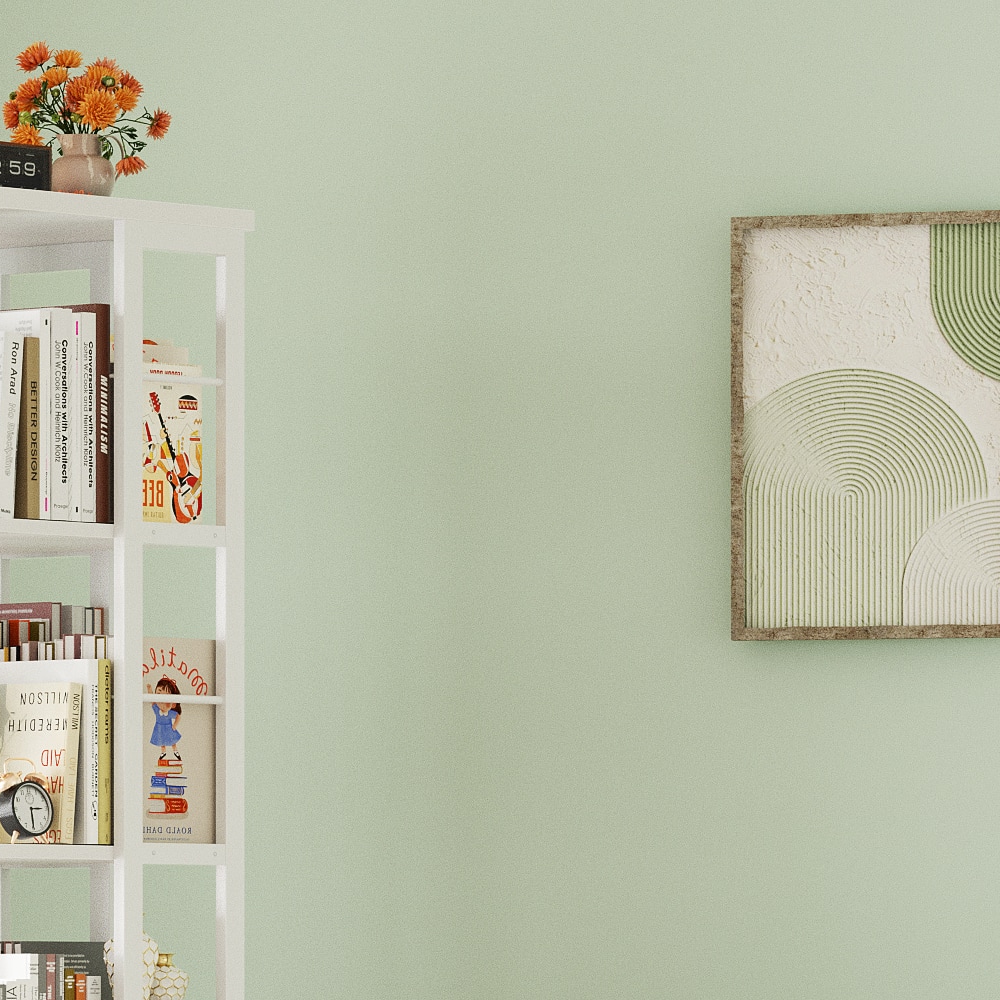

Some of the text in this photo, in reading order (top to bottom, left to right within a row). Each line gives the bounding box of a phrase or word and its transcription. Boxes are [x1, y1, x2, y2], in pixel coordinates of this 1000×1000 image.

[9, 161, 36, 177] 59
[11, 341, 20, 364] Ron
[9, 367, 18, 395] Arad
[100, 375, 108, 455] MINIMALISM
[30, 381, 38, 481] BETTER DESIGN
[72, 693, 81, 730] WILLSON
[41, 748, 66, 767] LAID
